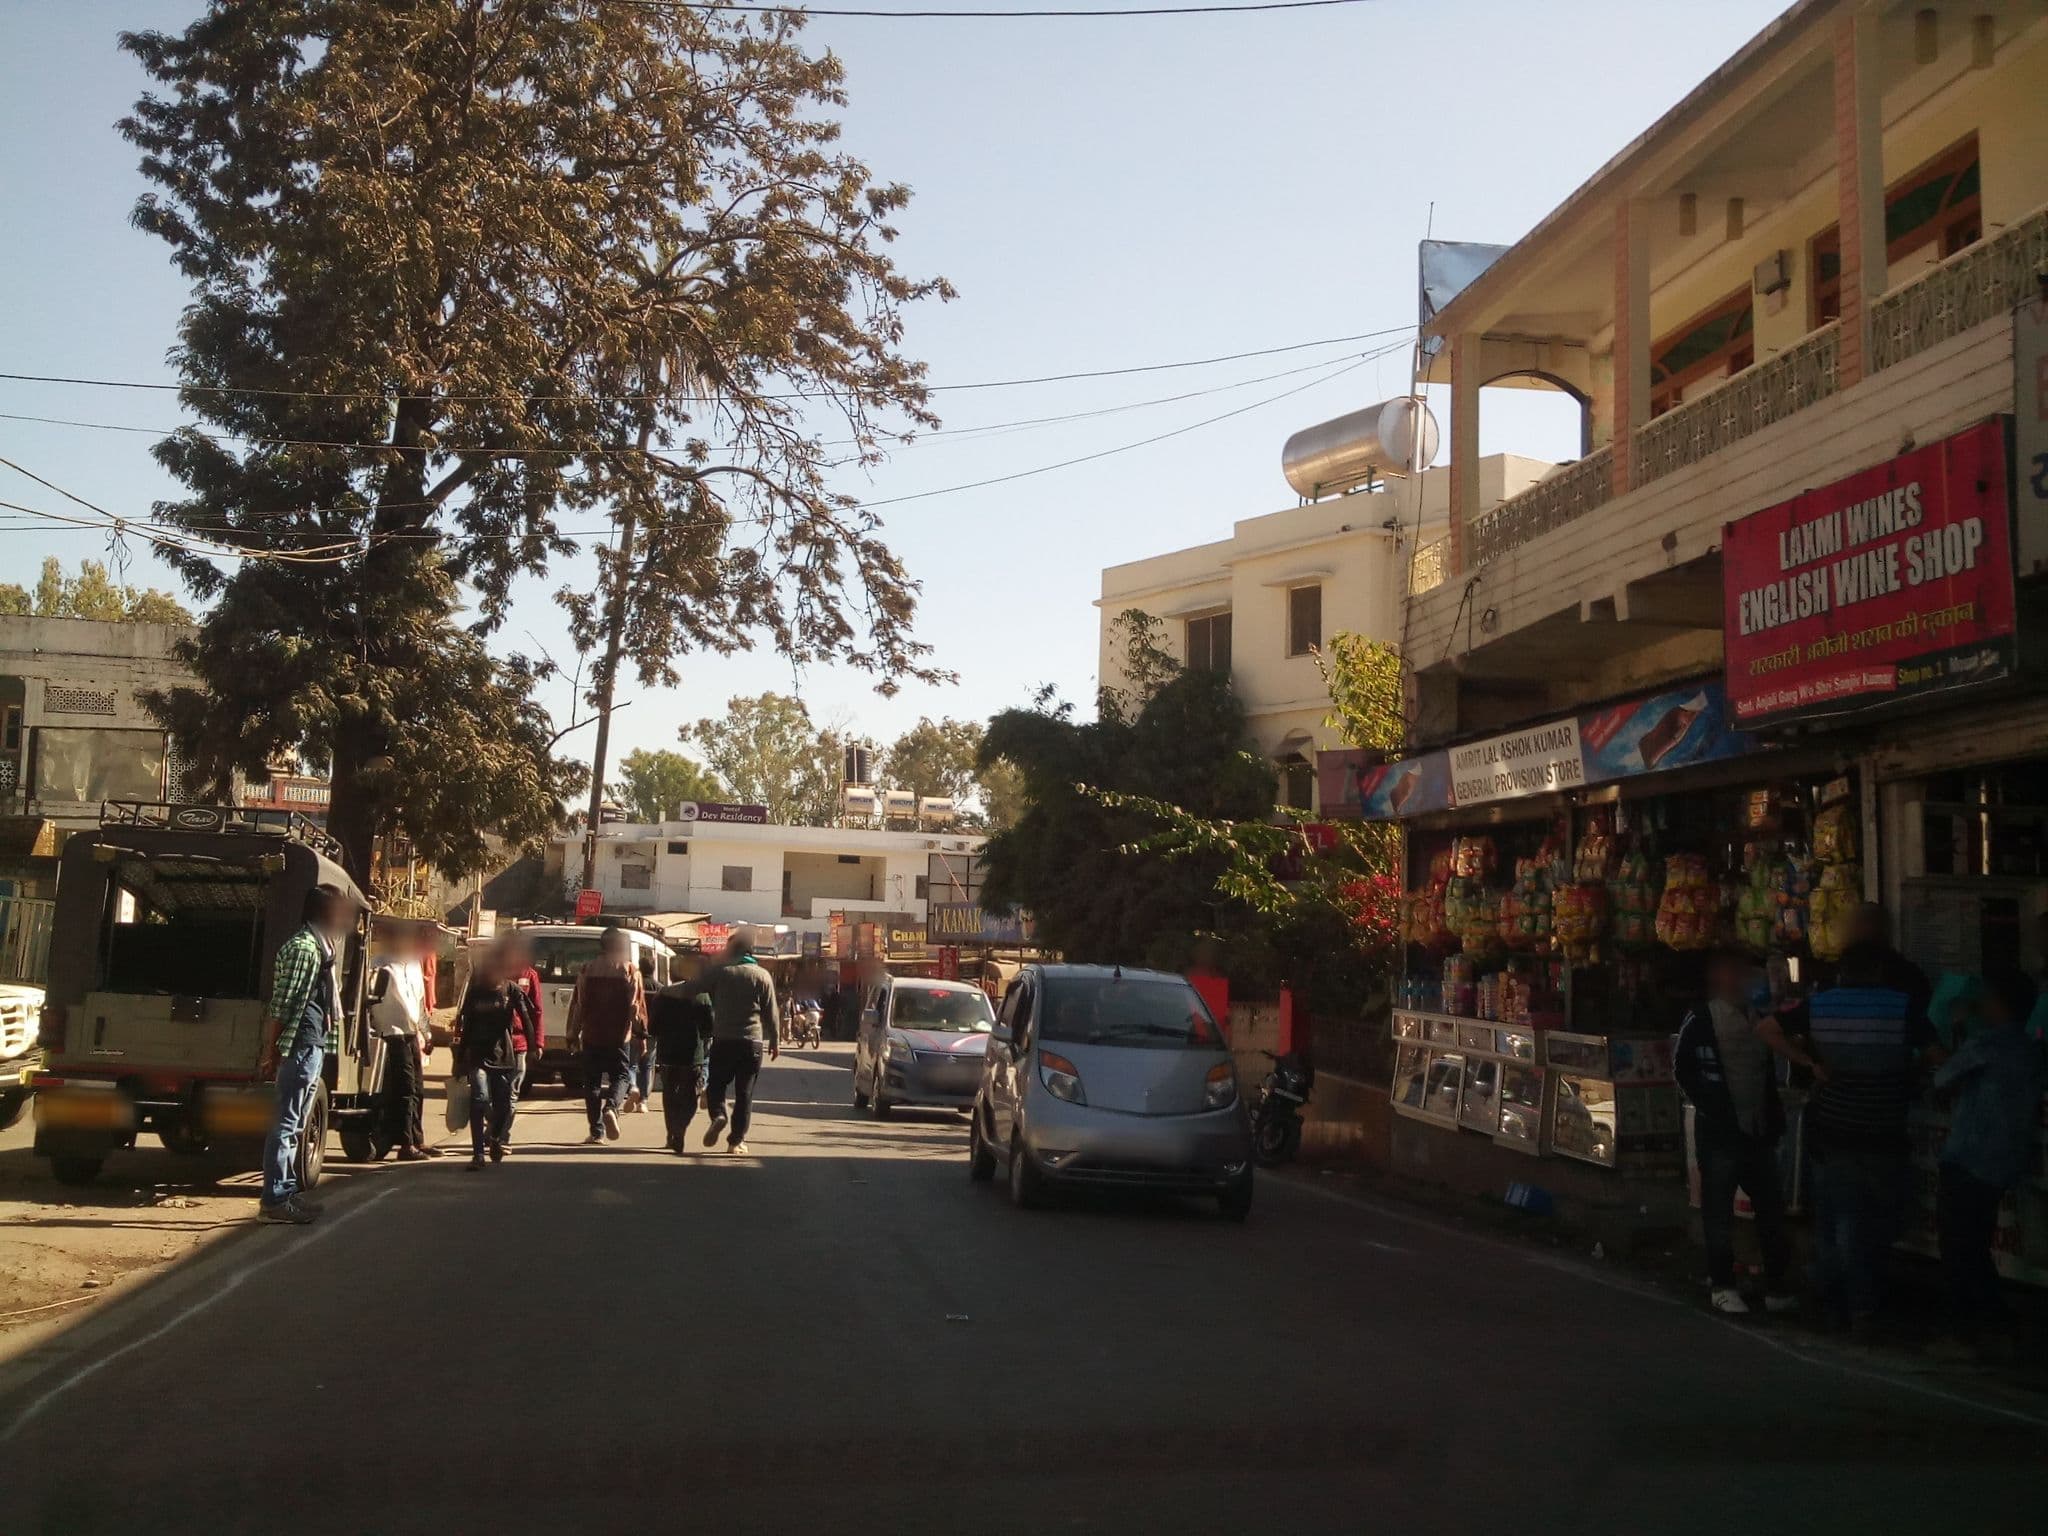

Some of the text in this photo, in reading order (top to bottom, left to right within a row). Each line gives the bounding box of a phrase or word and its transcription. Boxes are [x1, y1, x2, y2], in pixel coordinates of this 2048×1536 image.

[1779, 482, 1922, 571] LAXMI WINES
[1739, 517, 1983, 636] ENGLISH WINE SHOP
[1895, 611, 1919, 637] की
[1455, 726, 1573, 770] AMRIT LAL ASHOK KUMAR
[1456, 758, 1581, 800] GENERAL PROVISION STORE
[701, 811, 763, 824] Dev Residency
[942, 907, 982, 934] KANAK
